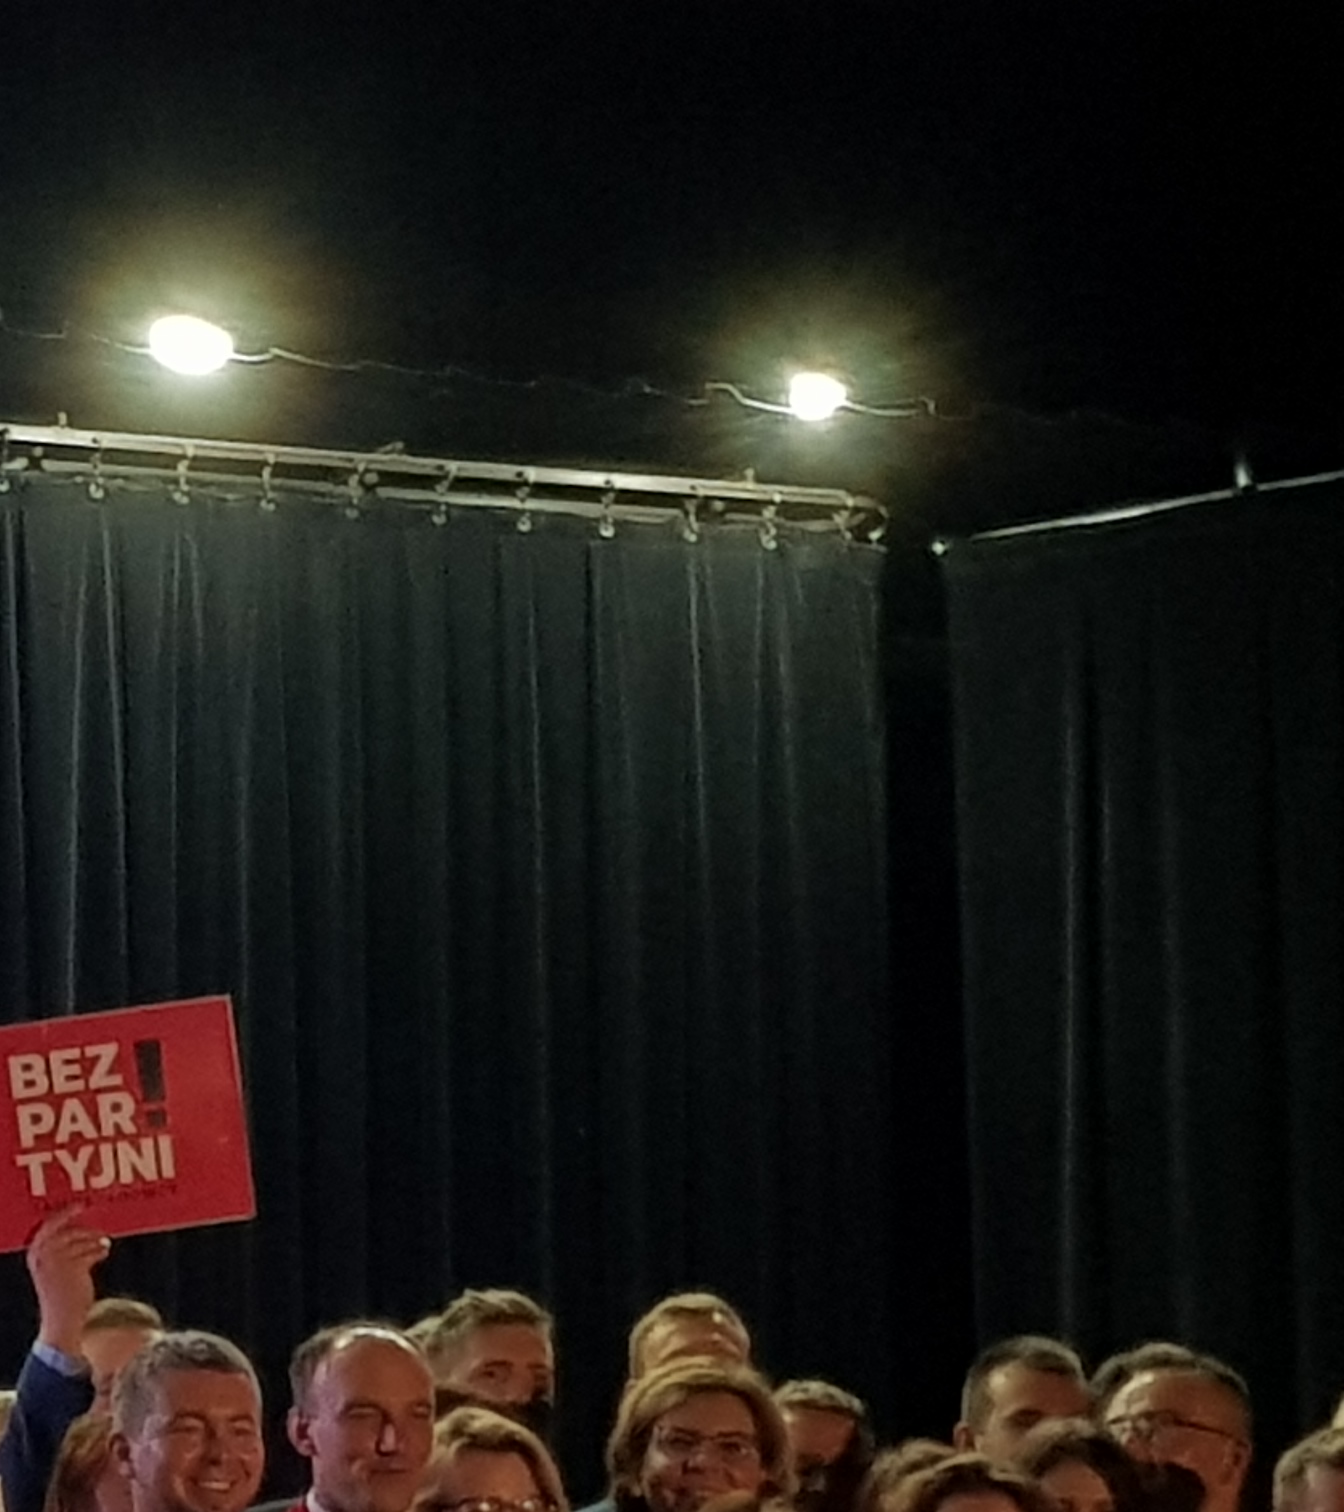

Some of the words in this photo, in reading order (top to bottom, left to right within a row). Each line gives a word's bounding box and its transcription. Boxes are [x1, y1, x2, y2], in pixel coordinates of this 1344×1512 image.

[7, 1042, 124, 1099] BEZ
[16, 1091, 137, 1149] PAR
[15, 1134, 176, 1197] TYJNI
